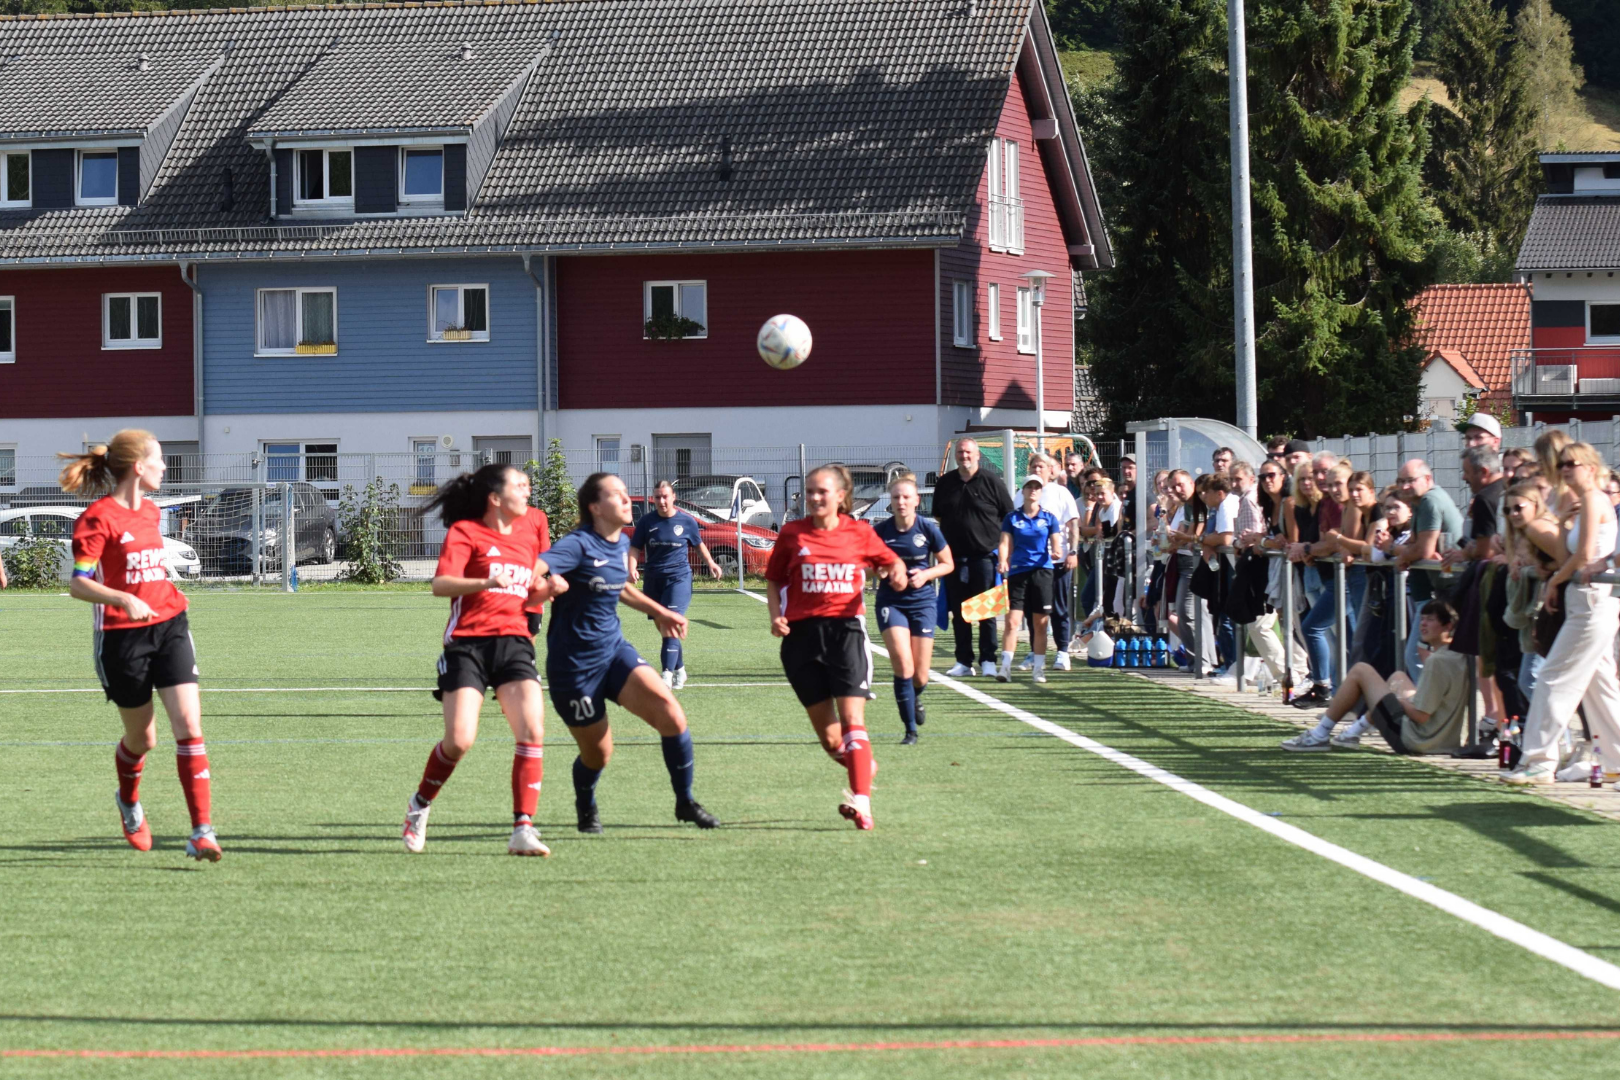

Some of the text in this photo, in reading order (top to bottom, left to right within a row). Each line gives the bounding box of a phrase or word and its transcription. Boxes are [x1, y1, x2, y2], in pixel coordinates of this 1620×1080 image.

[801, 563, 856, 581] REWE
[881, 606, 890, 623] 9
[569, 695, 596, 721] 20
